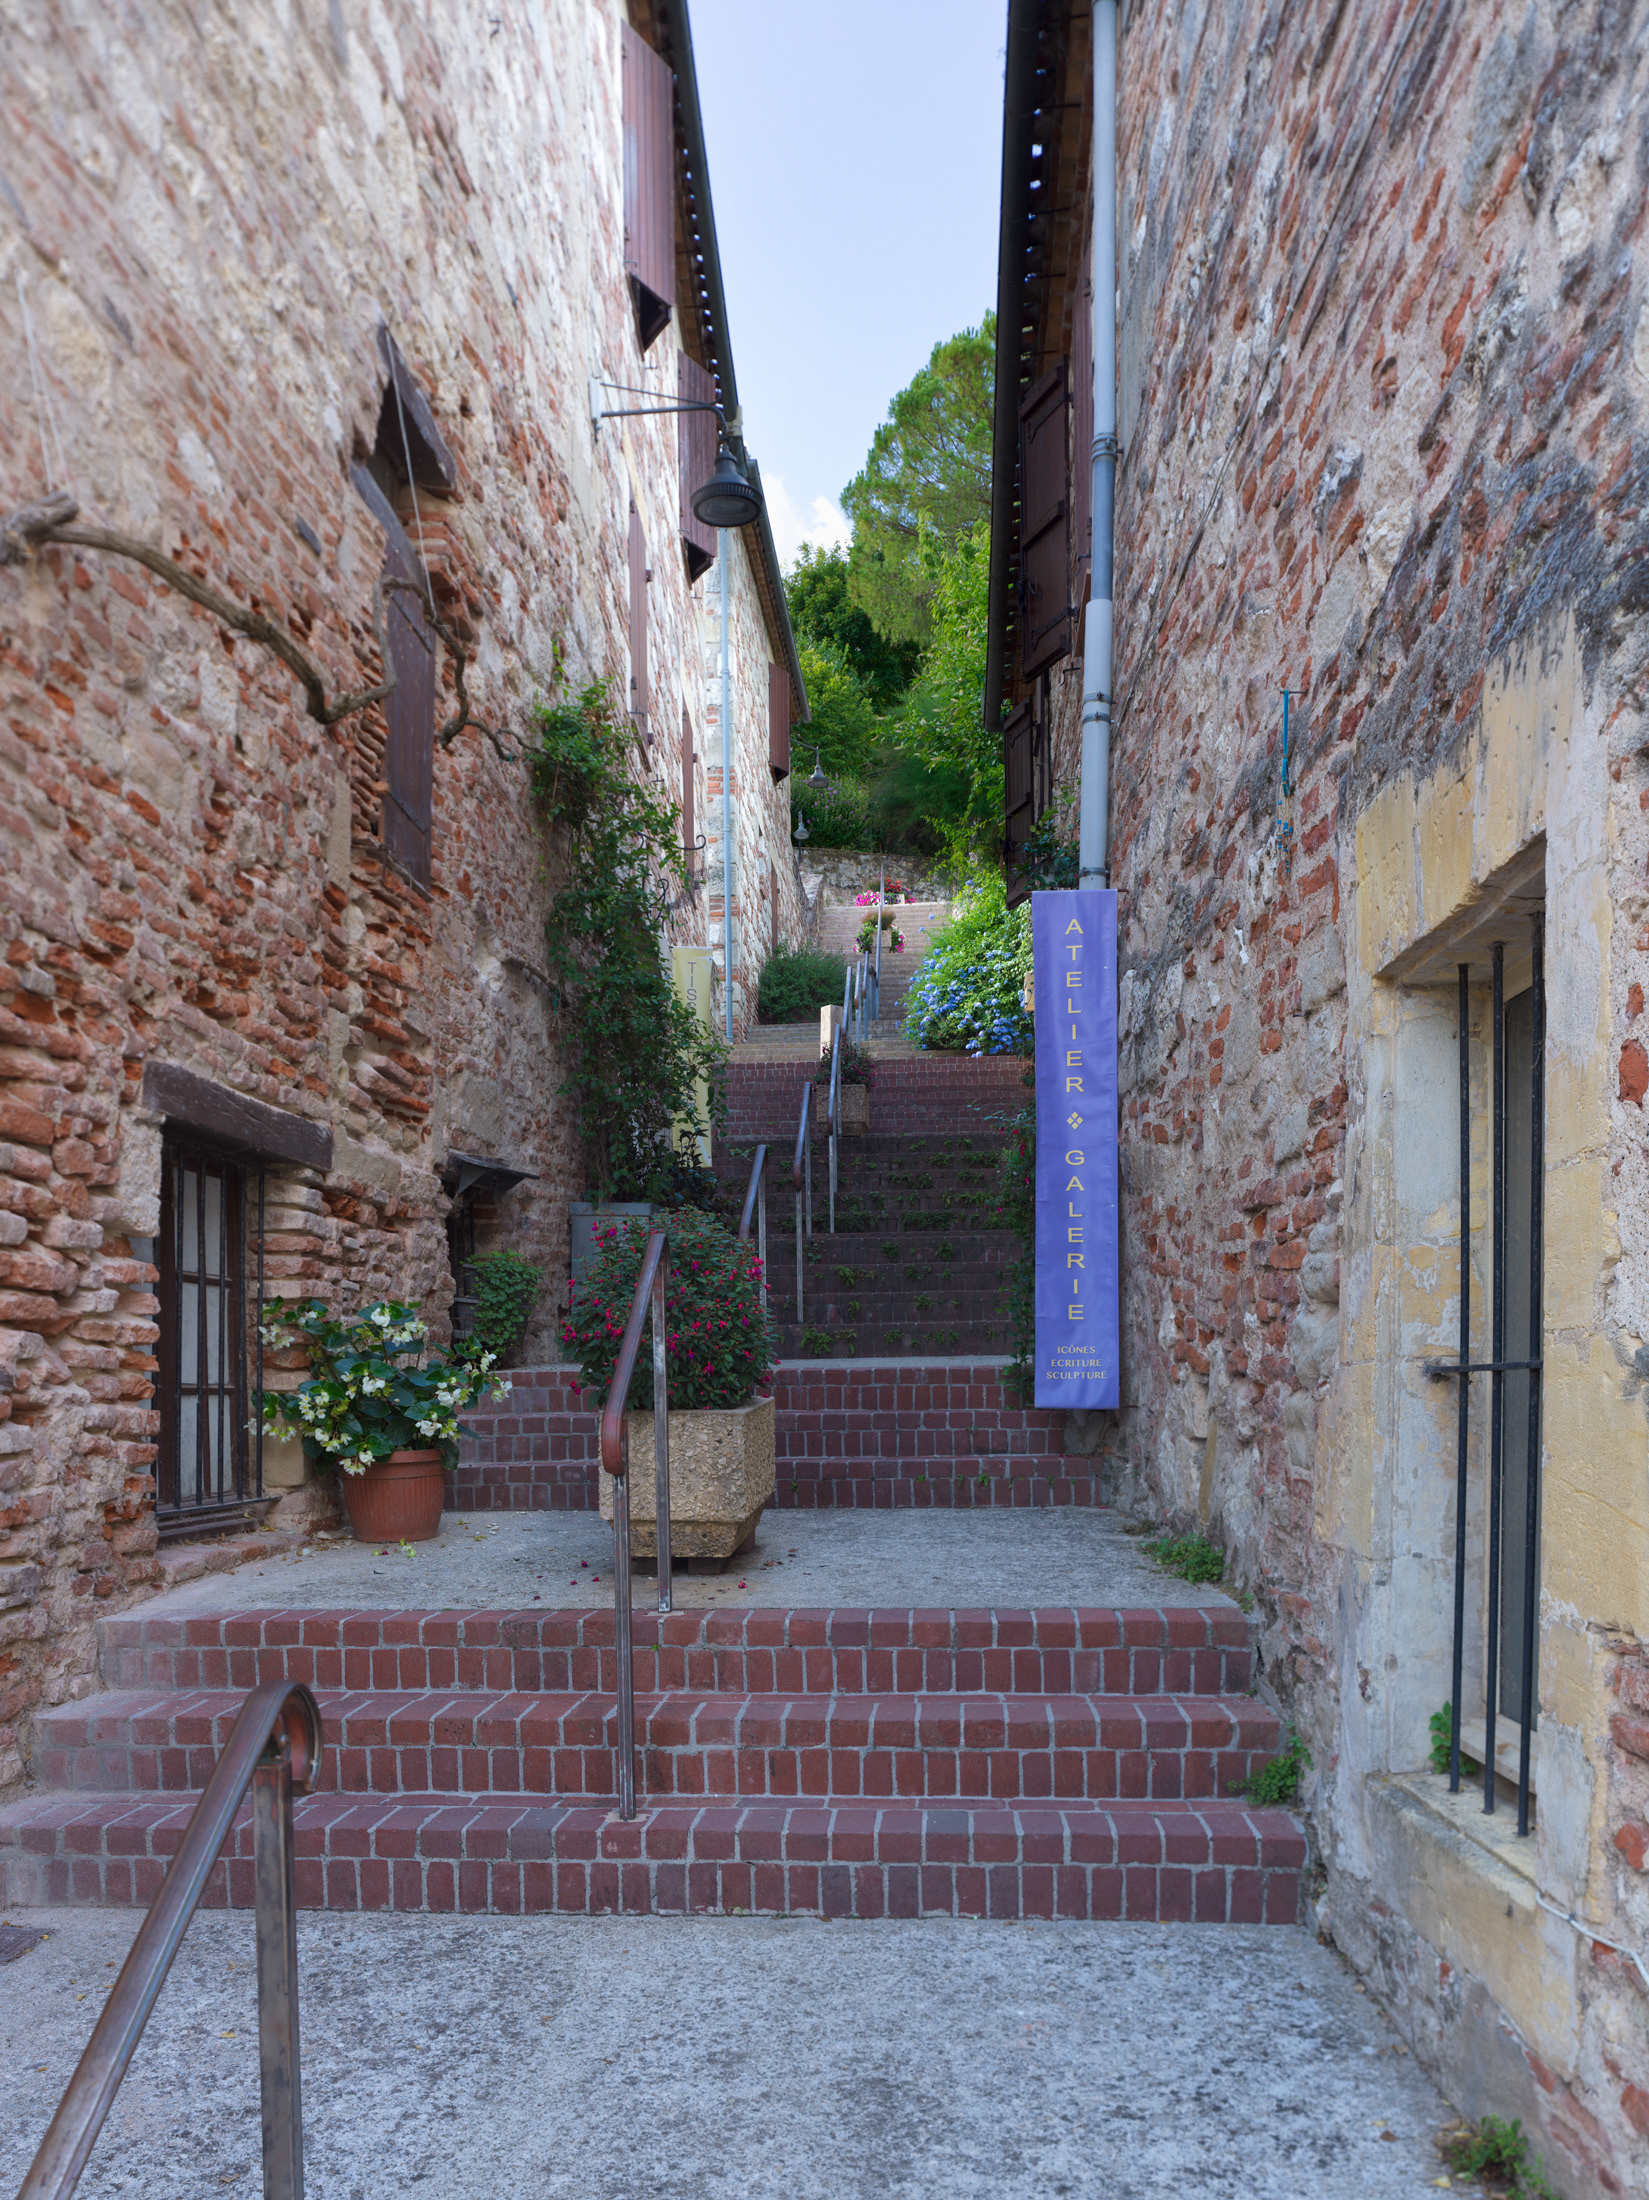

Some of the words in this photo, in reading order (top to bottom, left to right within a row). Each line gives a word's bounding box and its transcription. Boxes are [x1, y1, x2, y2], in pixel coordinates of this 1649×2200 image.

[1064, 918, 1085, 1093] ATELIER
[1065, 1149, 1086, 1320] GALERIE
[1057, 1344, 1096, 1354] ICÔNES
[1051, 1359, 1103, 1367] ECRITURE
[1046, 1371, 1107, 1380] SCULPTURE
